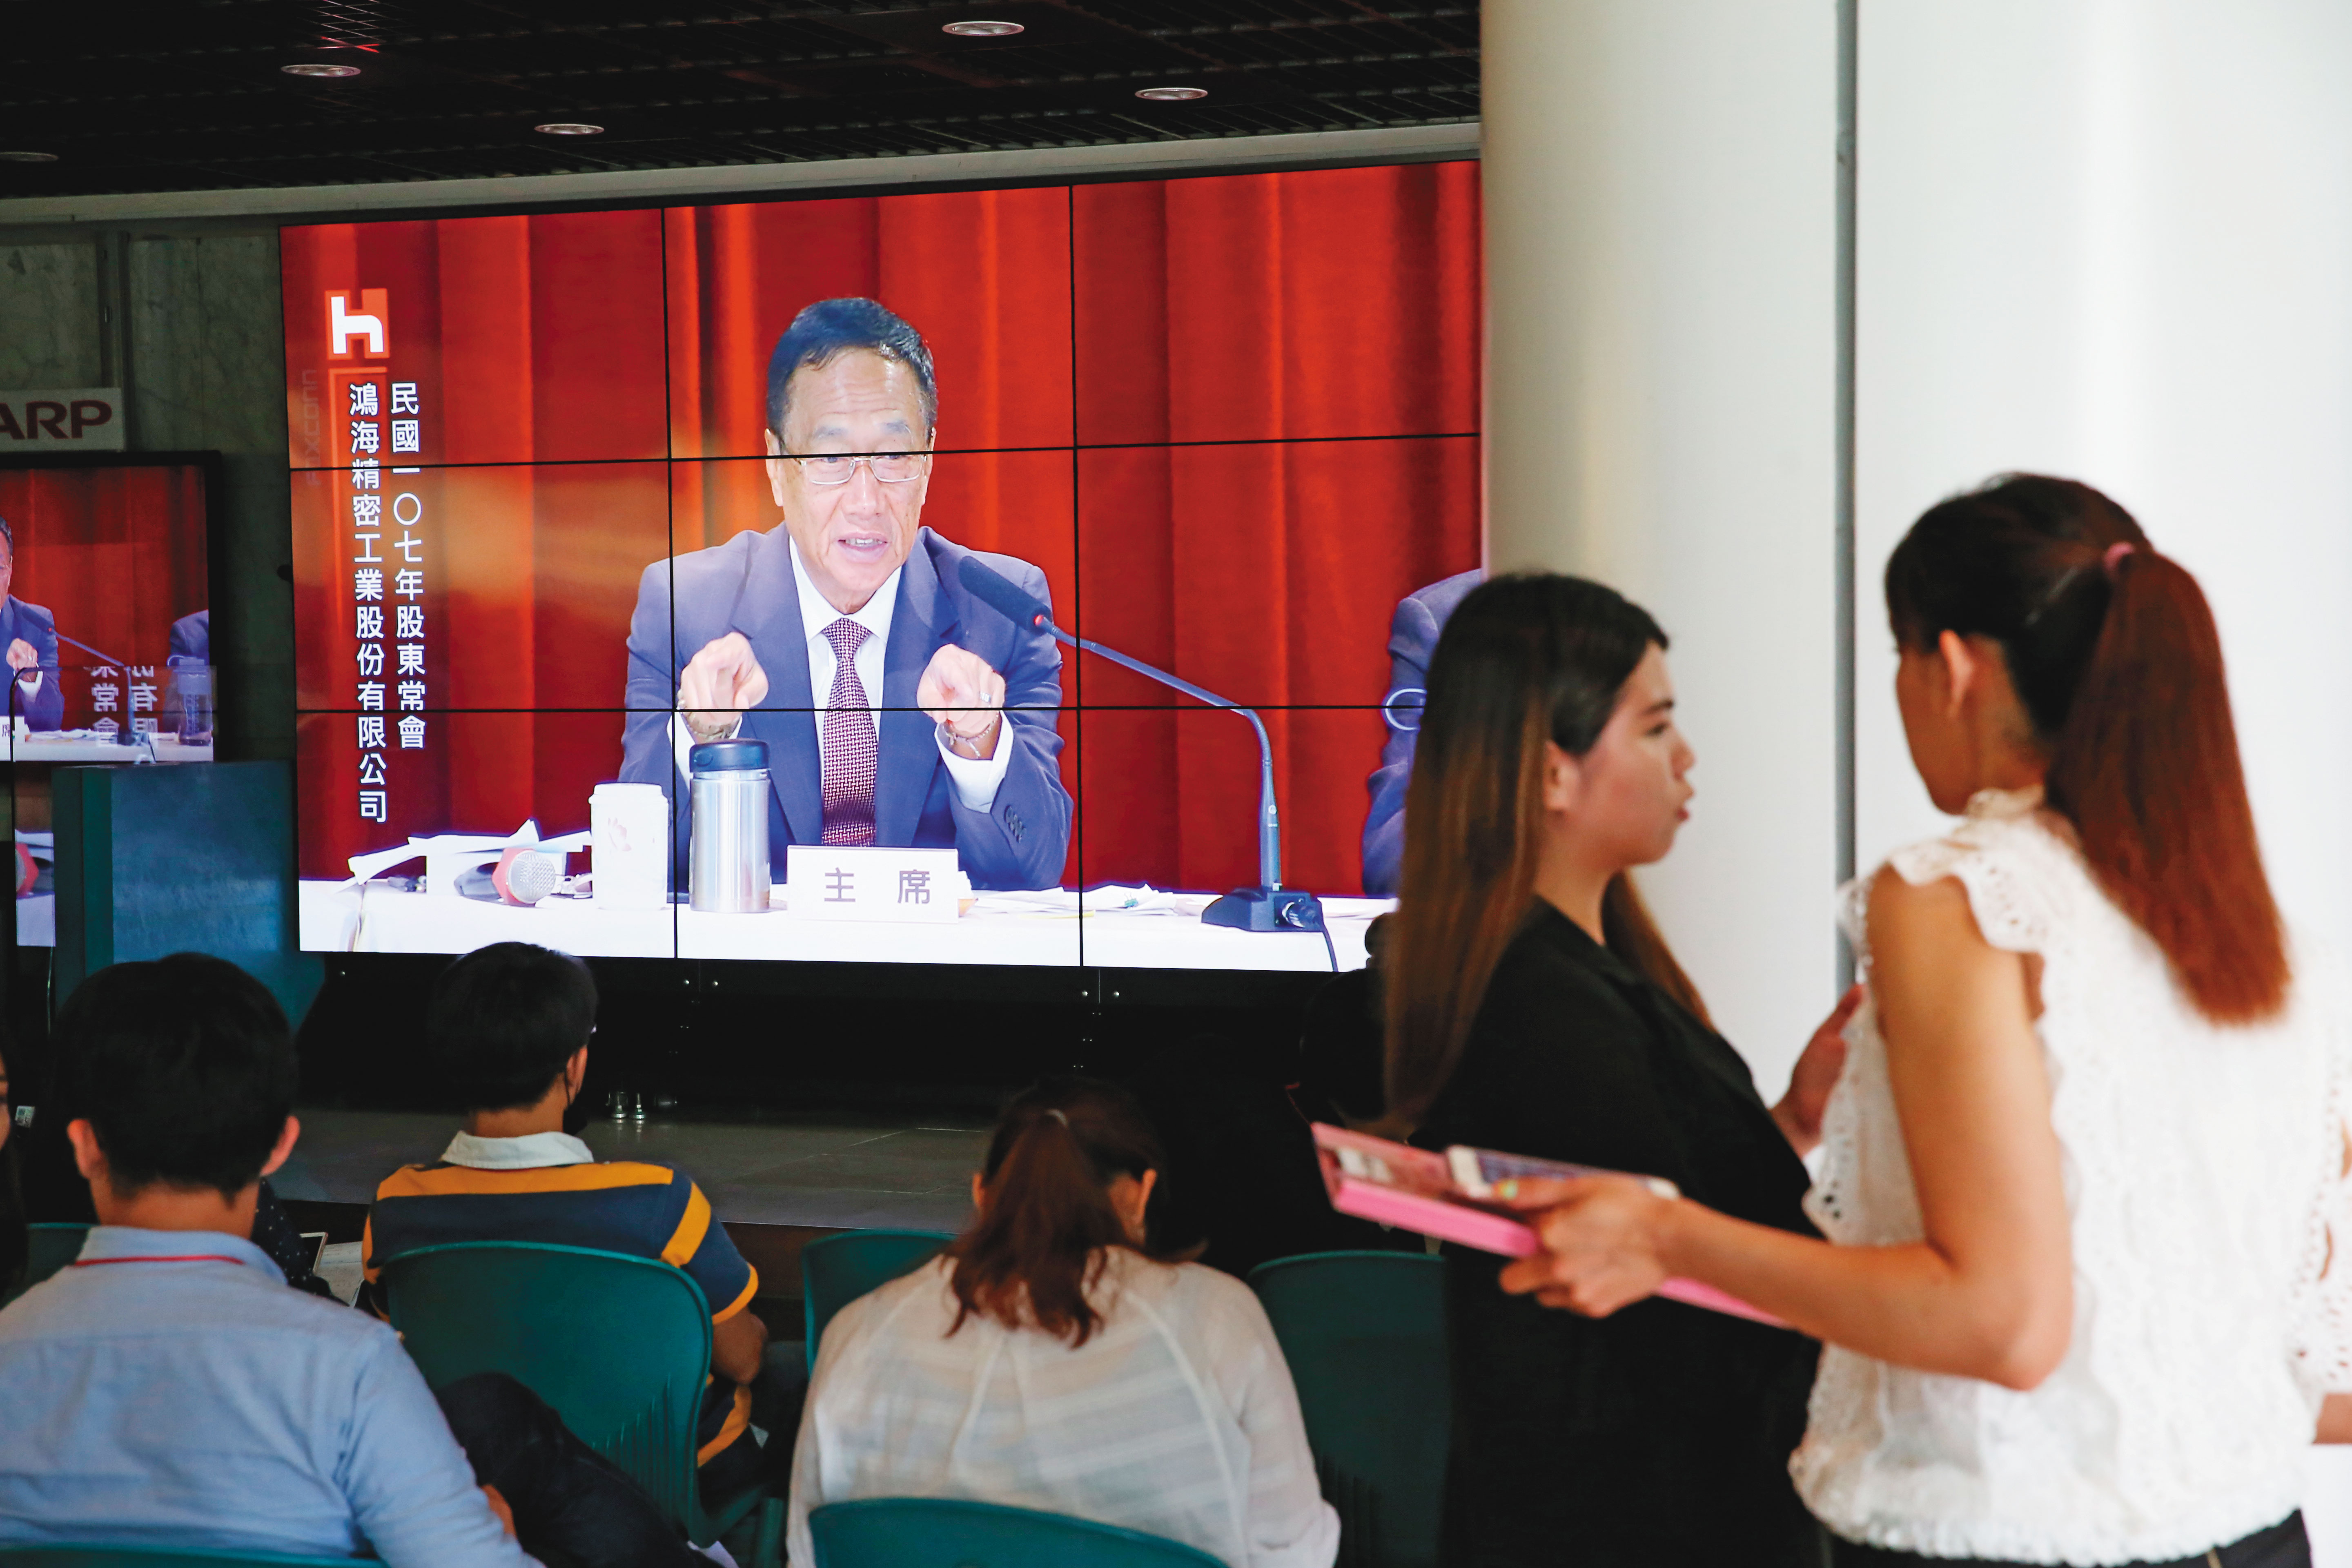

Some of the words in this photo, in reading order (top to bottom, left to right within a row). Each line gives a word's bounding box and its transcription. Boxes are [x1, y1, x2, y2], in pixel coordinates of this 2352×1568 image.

[349, 382, 387, 823] 鴻海精密工業股份有限公司
